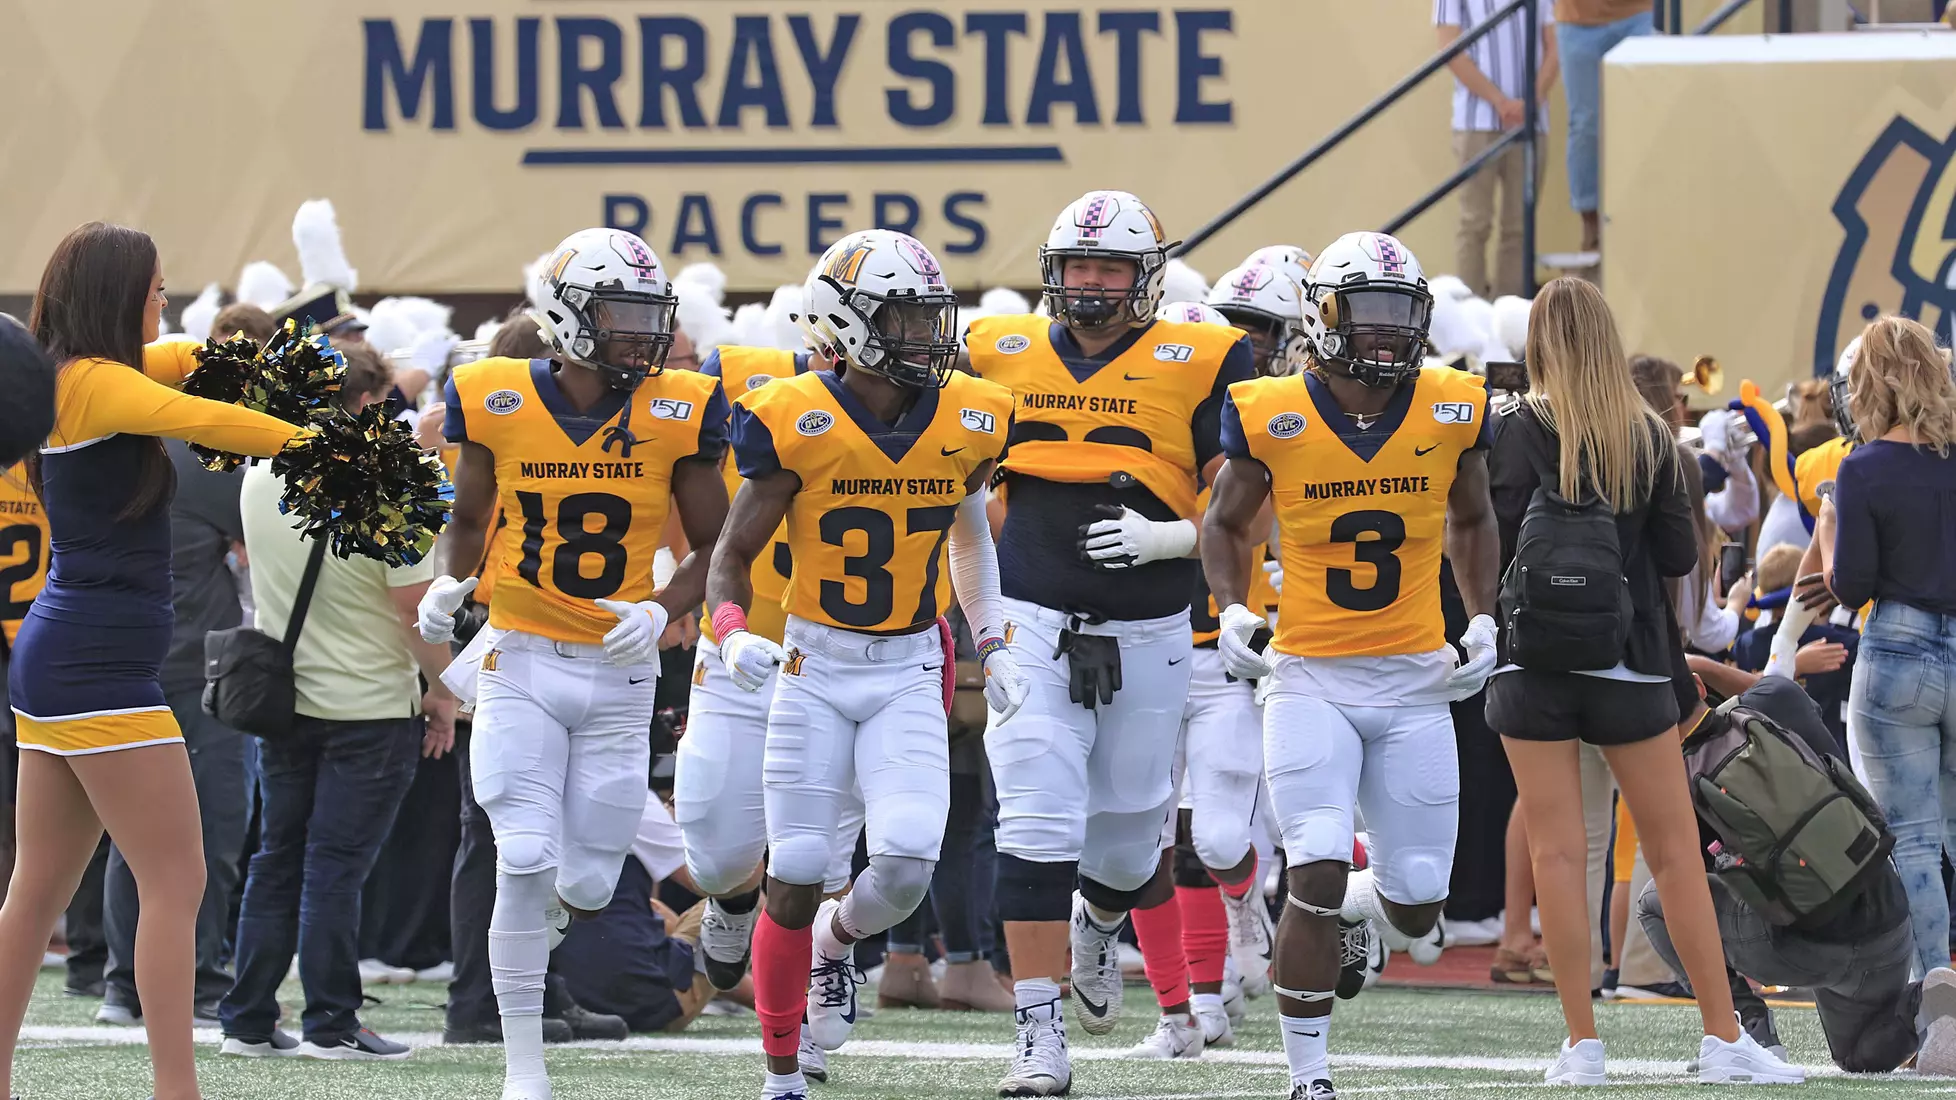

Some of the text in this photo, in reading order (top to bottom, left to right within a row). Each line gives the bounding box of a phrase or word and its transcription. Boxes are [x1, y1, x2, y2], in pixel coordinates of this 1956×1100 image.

[361, 9, 1232, 131] MURRAY STATE
[604, 193, 988, 255] RACERS
[1077, 239, 1099, 247] SPEED
[1383, 271, 1406, 279] SPEED
[1156, 344, 1192, 361] 150
[651, 399, 692, 420] 150
[1023, 393, 1137, 415] MURRAY STATE
[1434, 404, 1472, 422] 150
[961, 409, 995, 432] 150
[521, 462, 644, 479] MURRAY STATE
[832, 479, 955, 495] MURRAY STATE
[1304, 476, 1429, 499] MURRAY STATE
[0, 501, 38, 515] STATE
[515, 490, 632, 600] 18
[819, 503, 960, 627] 37
[1326, 509, 1407, 611] 3
[0, 524, 41, 621] 2
